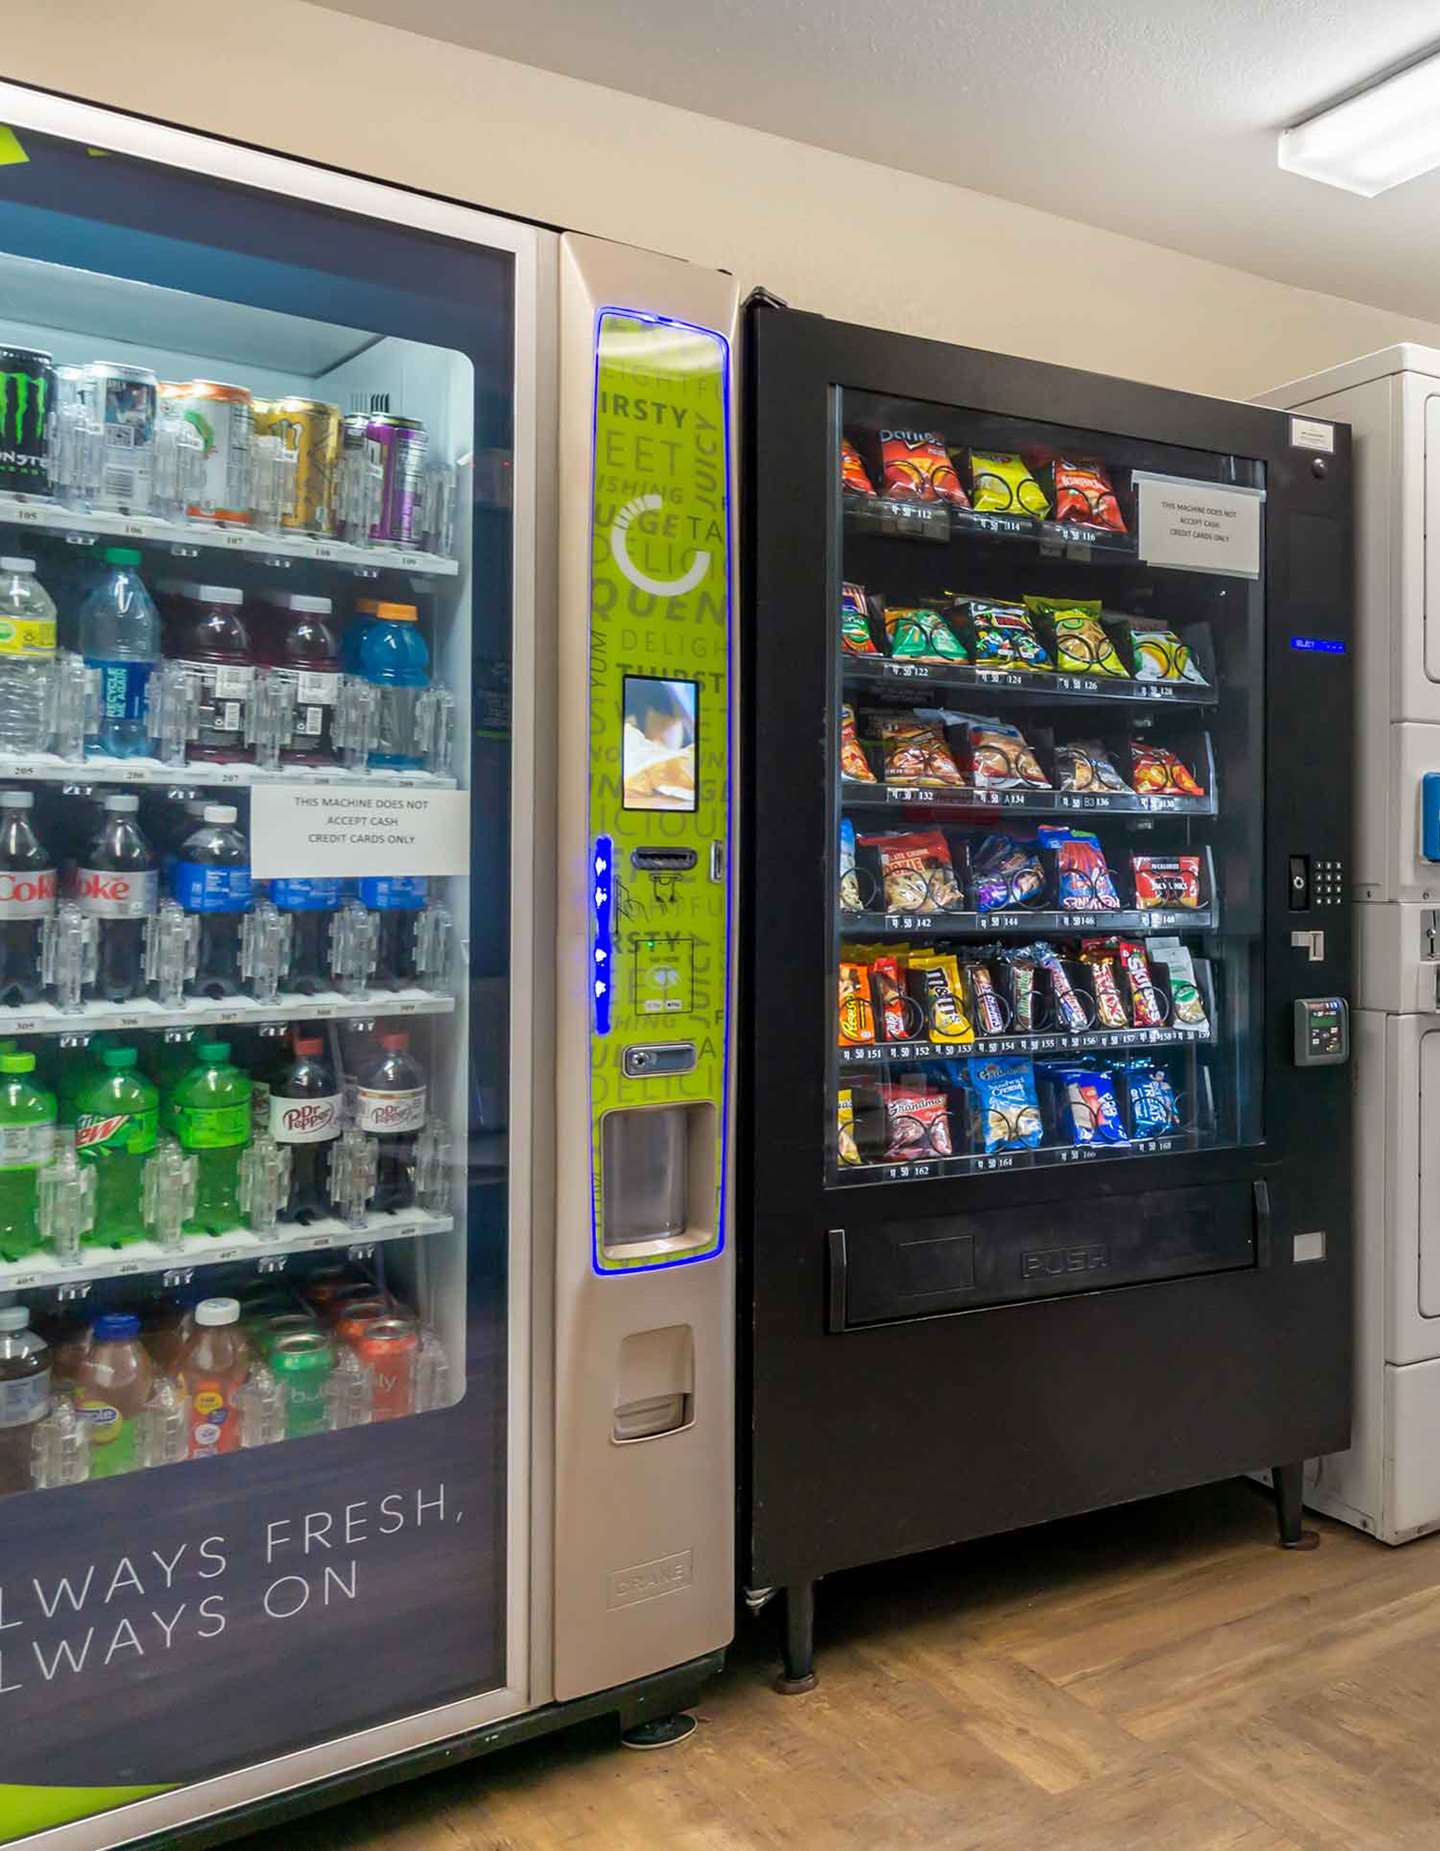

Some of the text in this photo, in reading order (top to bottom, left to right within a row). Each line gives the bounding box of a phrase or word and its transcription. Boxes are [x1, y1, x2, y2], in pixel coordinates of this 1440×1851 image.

[601, 391, 688, 429] IRSTY
[294, 797, 429, 810] THIS MACHINE DOES NOT
[327, 816, 399, 826] ACCEPT CASH
[308, 833, 416, 844] CREDIT CARDS ONLY
[867, 1049, 881, 1058] 151
[266, 1483, 463, 1563] FRESH,
[263, 1560, 357, 1618] ON
